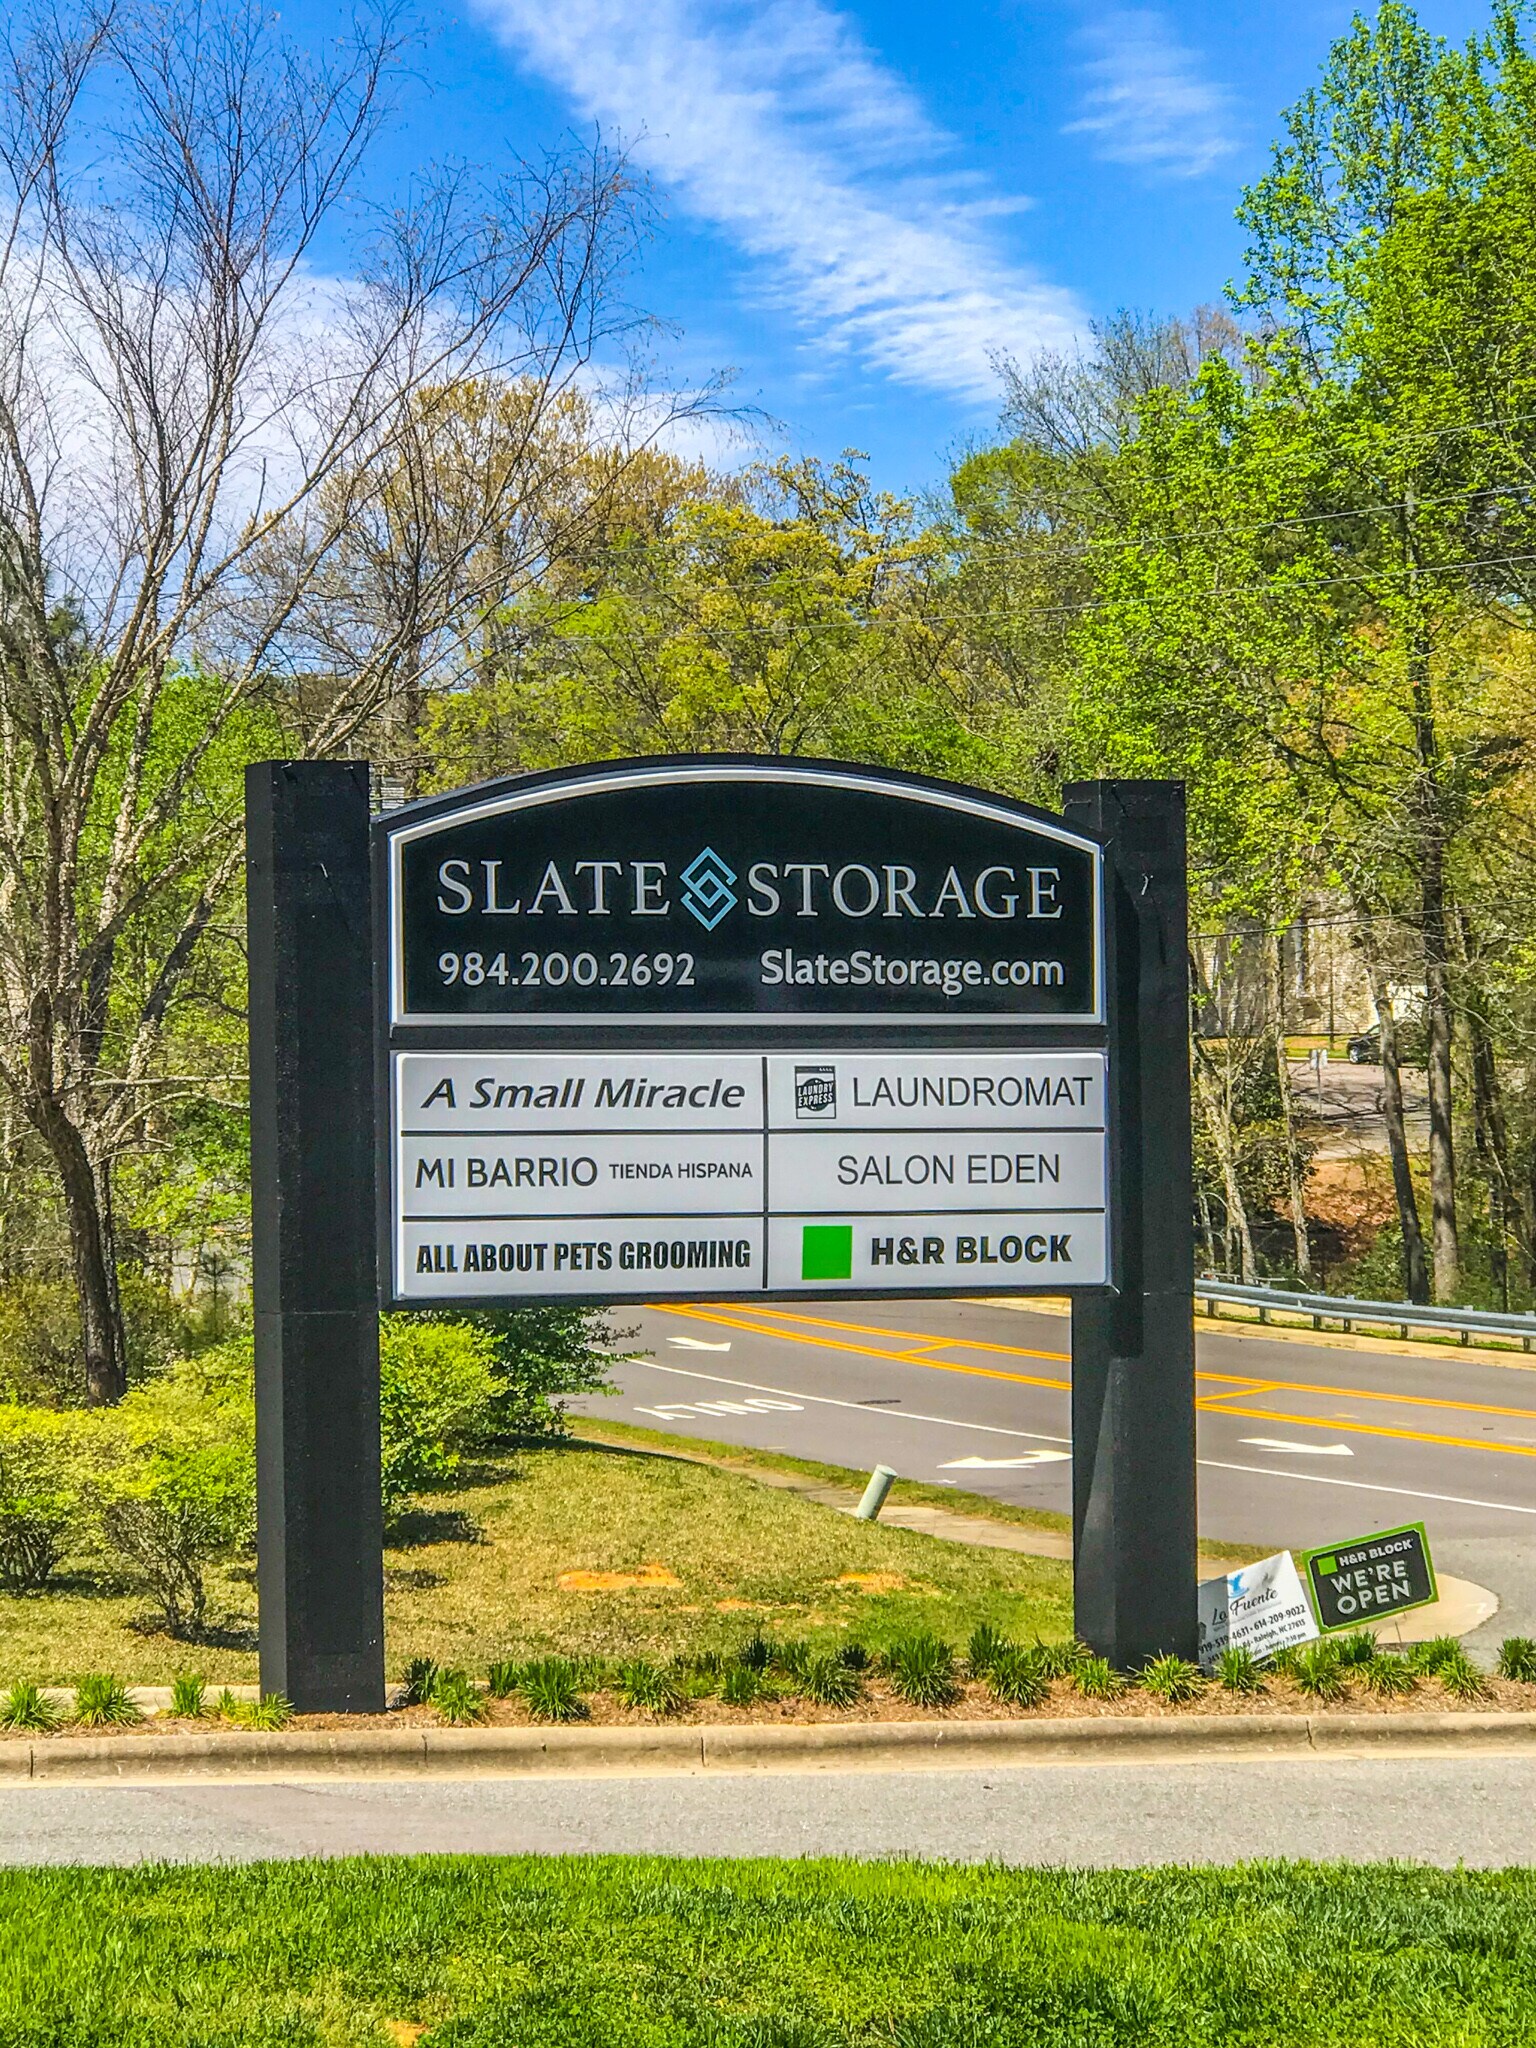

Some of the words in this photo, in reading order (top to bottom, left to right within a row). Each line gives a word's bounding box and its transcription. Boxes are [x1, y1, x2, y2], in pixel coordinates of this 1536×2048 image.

[438, 860, 670, 915] SLATE
[748, 864, 1063, 919] STORAGE
[439, 952, 695, 987] 984.200.2692
[761, 949, 1064, 998] SlateStorage.com
[421, 1078, 457, 1109] A
[469, 1077, 586, 1109] Small
[594, 1078, 746, 1109] Miracle
[797, 1083, 834, 1097] LAUNDRY
[798, 1093, 833, 1107] EXPRESS
[853, 1076, 1094, 1107] LAUNDROMAT
[416, 1158, 455, 1188] MI
[467, 1156, 598, 1188] BARRIO
[609, 1163, 674, 1179] TIENDA
[677, 1162, 753, 1179] HISPANA
[837, 1154, 954, 1186] SALON
[967, 1153, 1060, 1184] EDEN
[416, 1244, 459, 1274] ALL
[463, 1243, 548, 1273] ABOUT
[553, 1241, 612, 1271] PETS
[618, 1239, 751, 1270] GROOMING
[870, 1236, 944, 1266] H&R
[955, 1234, 1073, 1264] BLOCK
[1339, 1551, 1367, 1567] H&R
[1369, 1540, 1412, 1559] BLOCK
[1330, 1560, 1407, 1593] WE'RE
[1229, 1587, 1279, 1616] Fuente
[1337, 1580, 1410, 1615] OPEN
[1253, 1604, 1306, 1631] 614-209-9022
